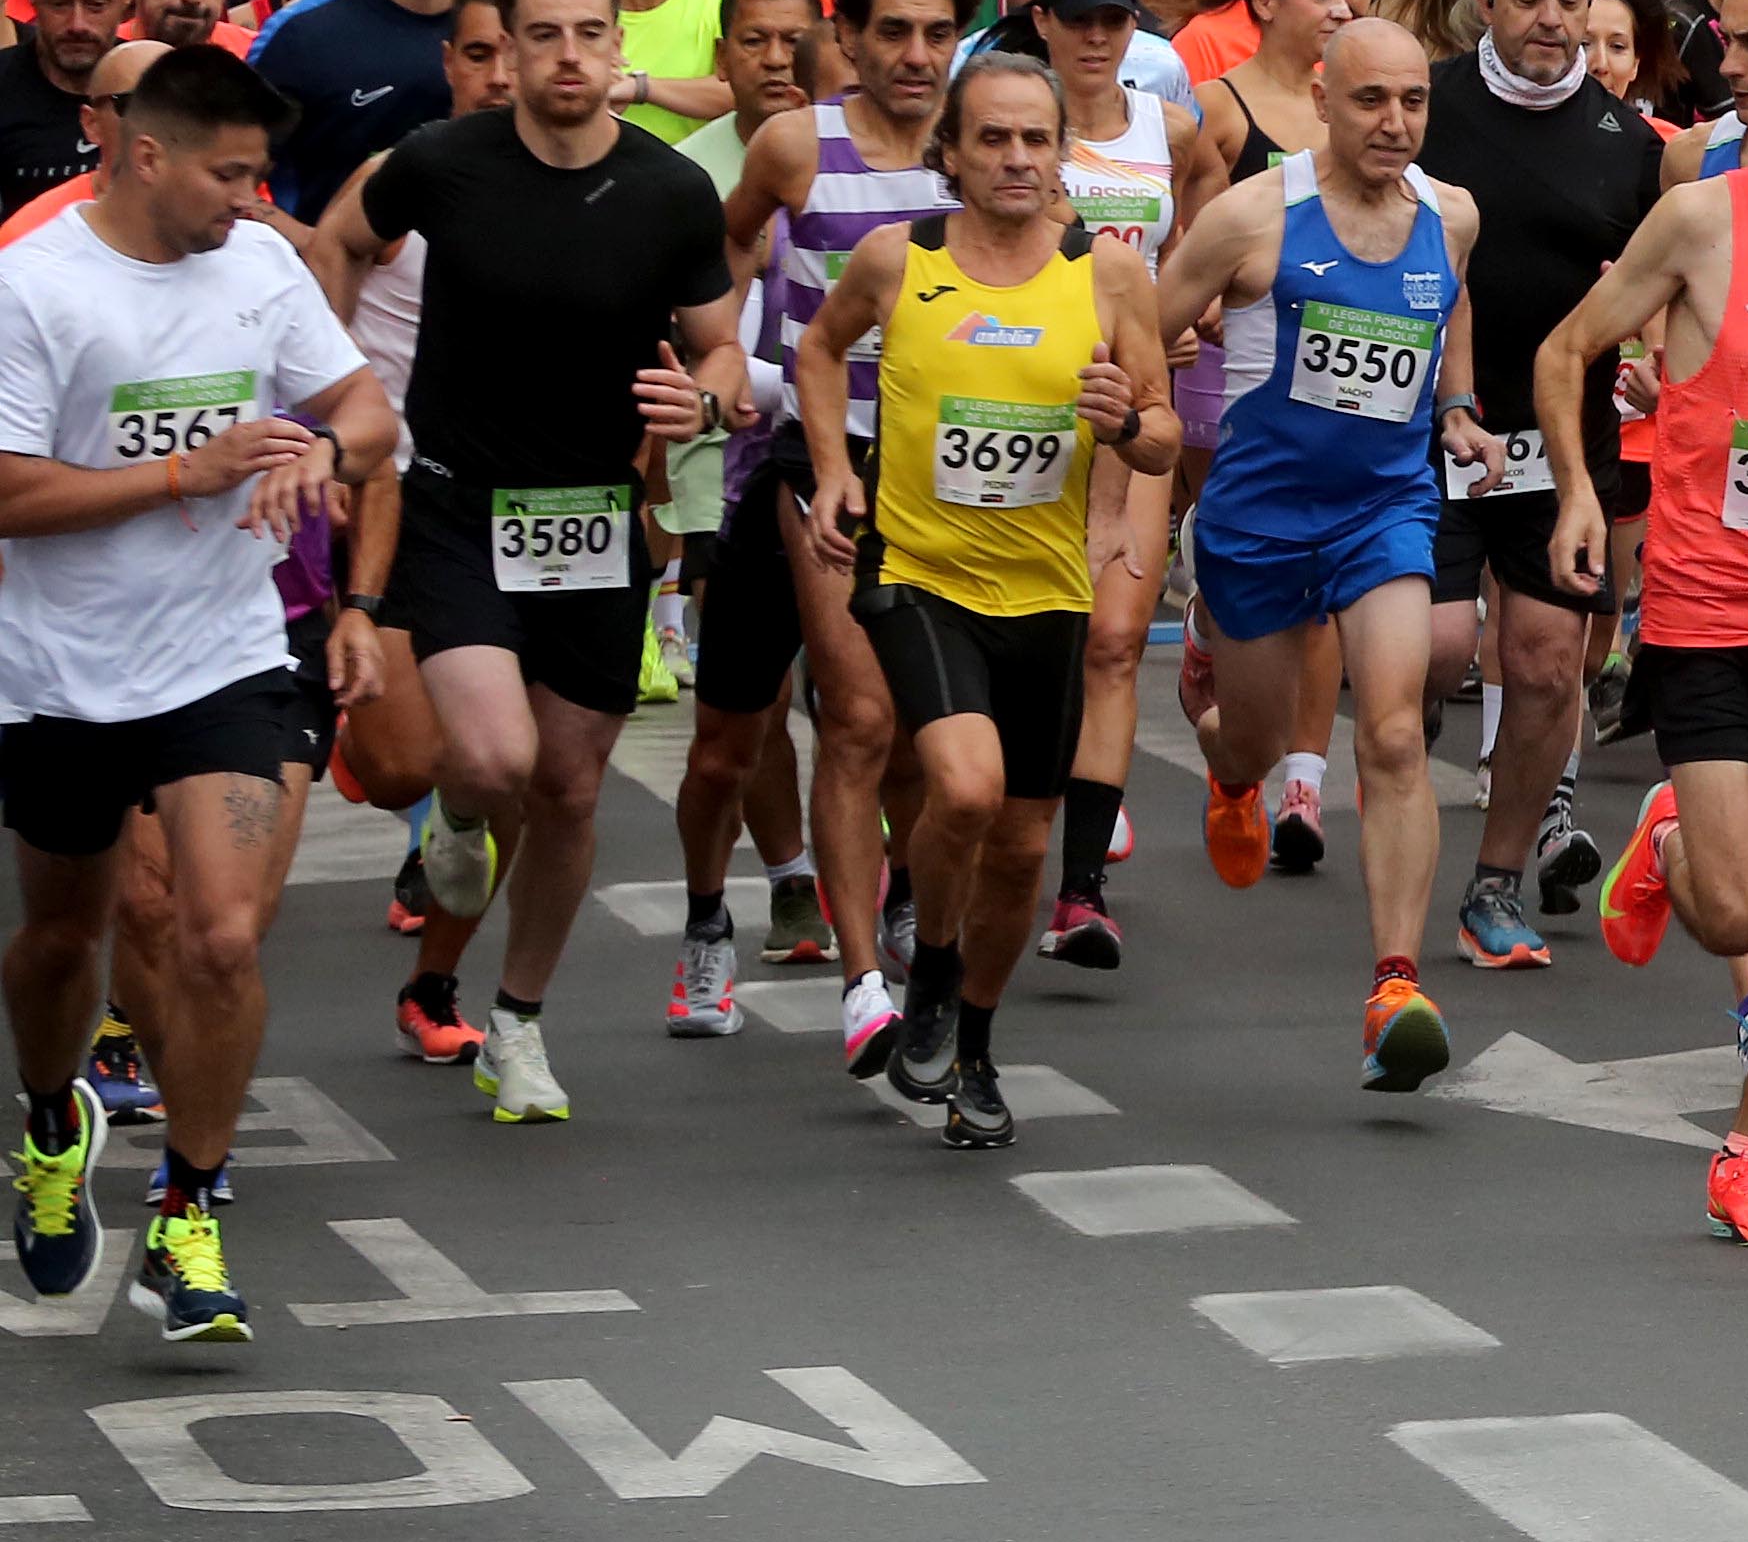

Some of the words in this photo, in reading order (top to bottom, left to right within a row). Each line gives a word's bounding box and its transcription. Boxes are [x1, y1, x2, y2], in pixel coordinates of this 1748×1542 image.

[1317, 306, 1330, 316] XI
[1333, 309, 1373, 324] LEGUA
[1375, 314, 1427, 333] POPULAR
[1328, 319, 1344, 332] DE
[1348, 321, 1420, 343] VALLADOLID
[1302, 333, 1417, 389] 3550
[1338, 386, 1373, 399] NACHO
[941, 428, 1061, 474] 3699
[501, 515, 612, 558] 3580
